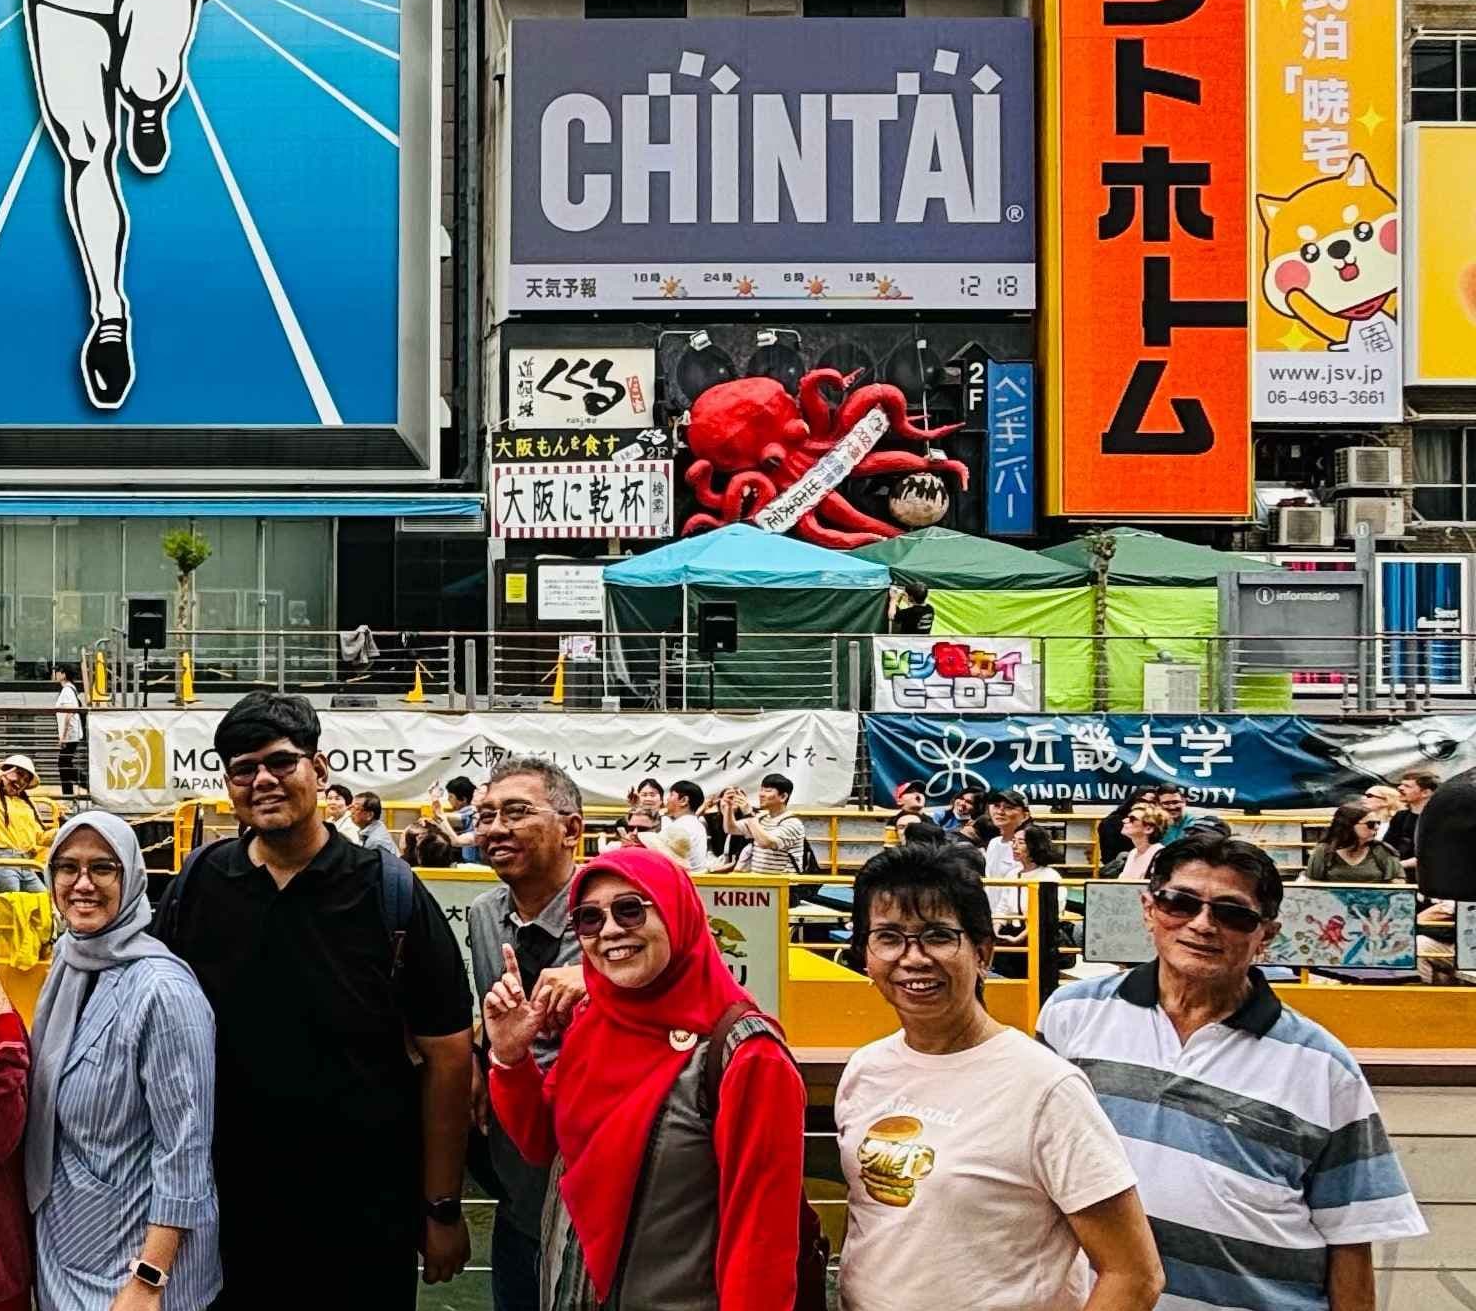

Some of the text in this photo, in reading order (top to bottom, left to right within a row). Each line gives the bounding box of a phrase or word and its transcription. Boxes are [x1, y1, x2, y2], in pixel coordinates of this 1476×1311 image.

[540, 49, 1003, 232] CHINTAI
[525, 278, 597, 299] 天気予報
[1269, 365, 1383, 382] www.jsv.jp
[536, 358, 626, 416] くくる
[1267, 390, 1385, 405] 06-4963-3661
[495, 433, 621, 459] 大阪もんを食す
[646, 446, 669, 460] 2F
[995, 376, 1028, 518] ペンギンバー
[502, 475, 645, 524] 大阪に乾杯
[1275, 590, 1341, 602] information
[173, 748, 226, 773] MG
[1008, 724, 1234, 778] 近畿大学
[1012, 783, 1091, 800] KINDAI
[713, 891, 770, 907] KIRIN
